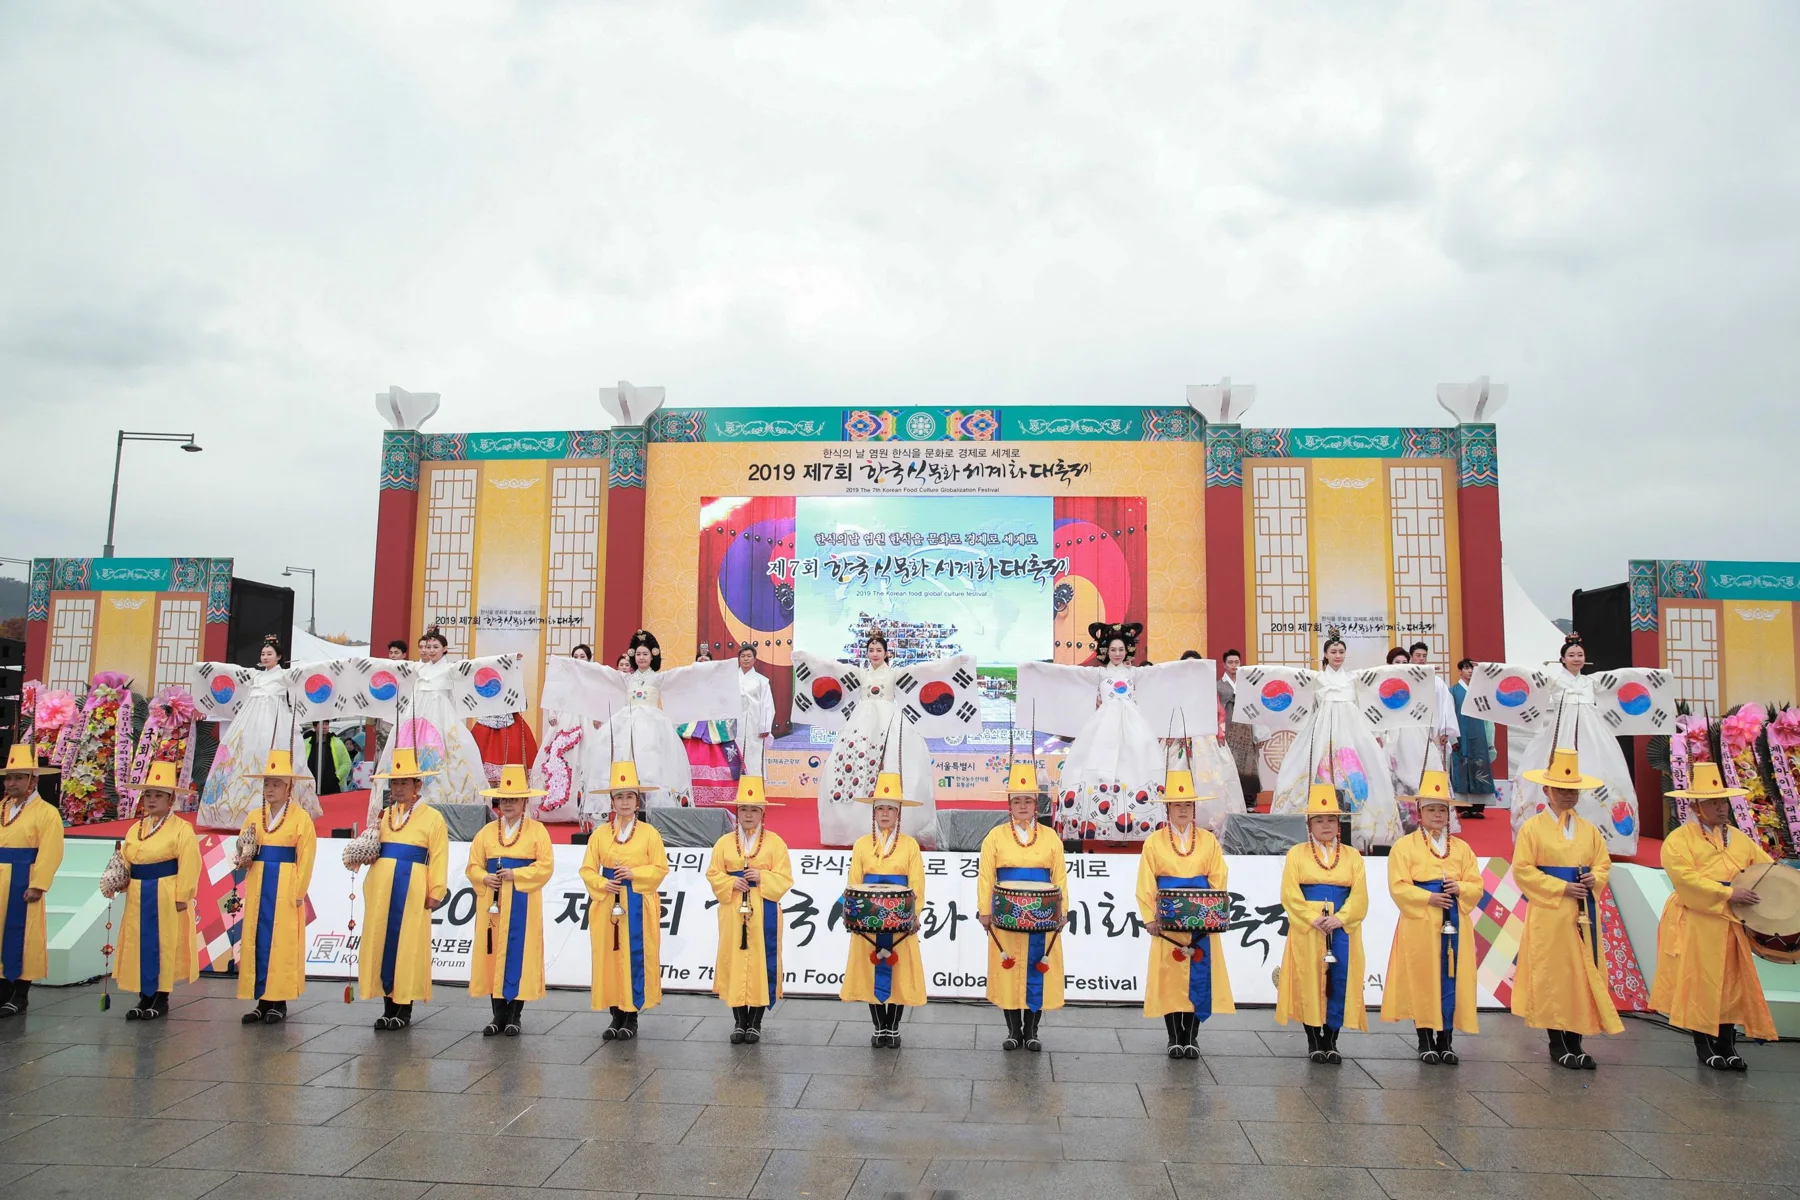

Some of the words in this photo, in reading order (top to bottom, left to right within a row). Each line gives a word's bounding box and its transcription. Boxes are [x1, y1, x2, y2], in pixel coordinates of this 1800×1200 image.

[823, 448, 852, 459] 한식의
[855, 448, 865, 459] 날
[869, 448, 888, 459] 염원
[892, 448, 921, 459] 한식을
[925, 448, 954, 458] 문화로
[958, 448, 987, 458] 경제로
[991, 448, 1021, 458] 세계로
[748, 463, 796, 481] 2019
[803, 462, 852, 482] 제7회
[927, 533, 962, 545] 문화로
[965, 533, 1000, 545] 경제로
[923, 590, 942, 598] global
[435, 616, 456, 625] 2019
[459, 616, 481, 625] 제7회
[1271, 622, 1295, 632] 2019
[1297, 622, 1322, 632] 제7회
[936, 762, 976, 771] 서울특별시
[1785, 804, 1800, 824] 대표
[660, 965, 690, 980] The
[698, 966, 714, 980] 7t
[1064, 974, 1137, 991] Festival
